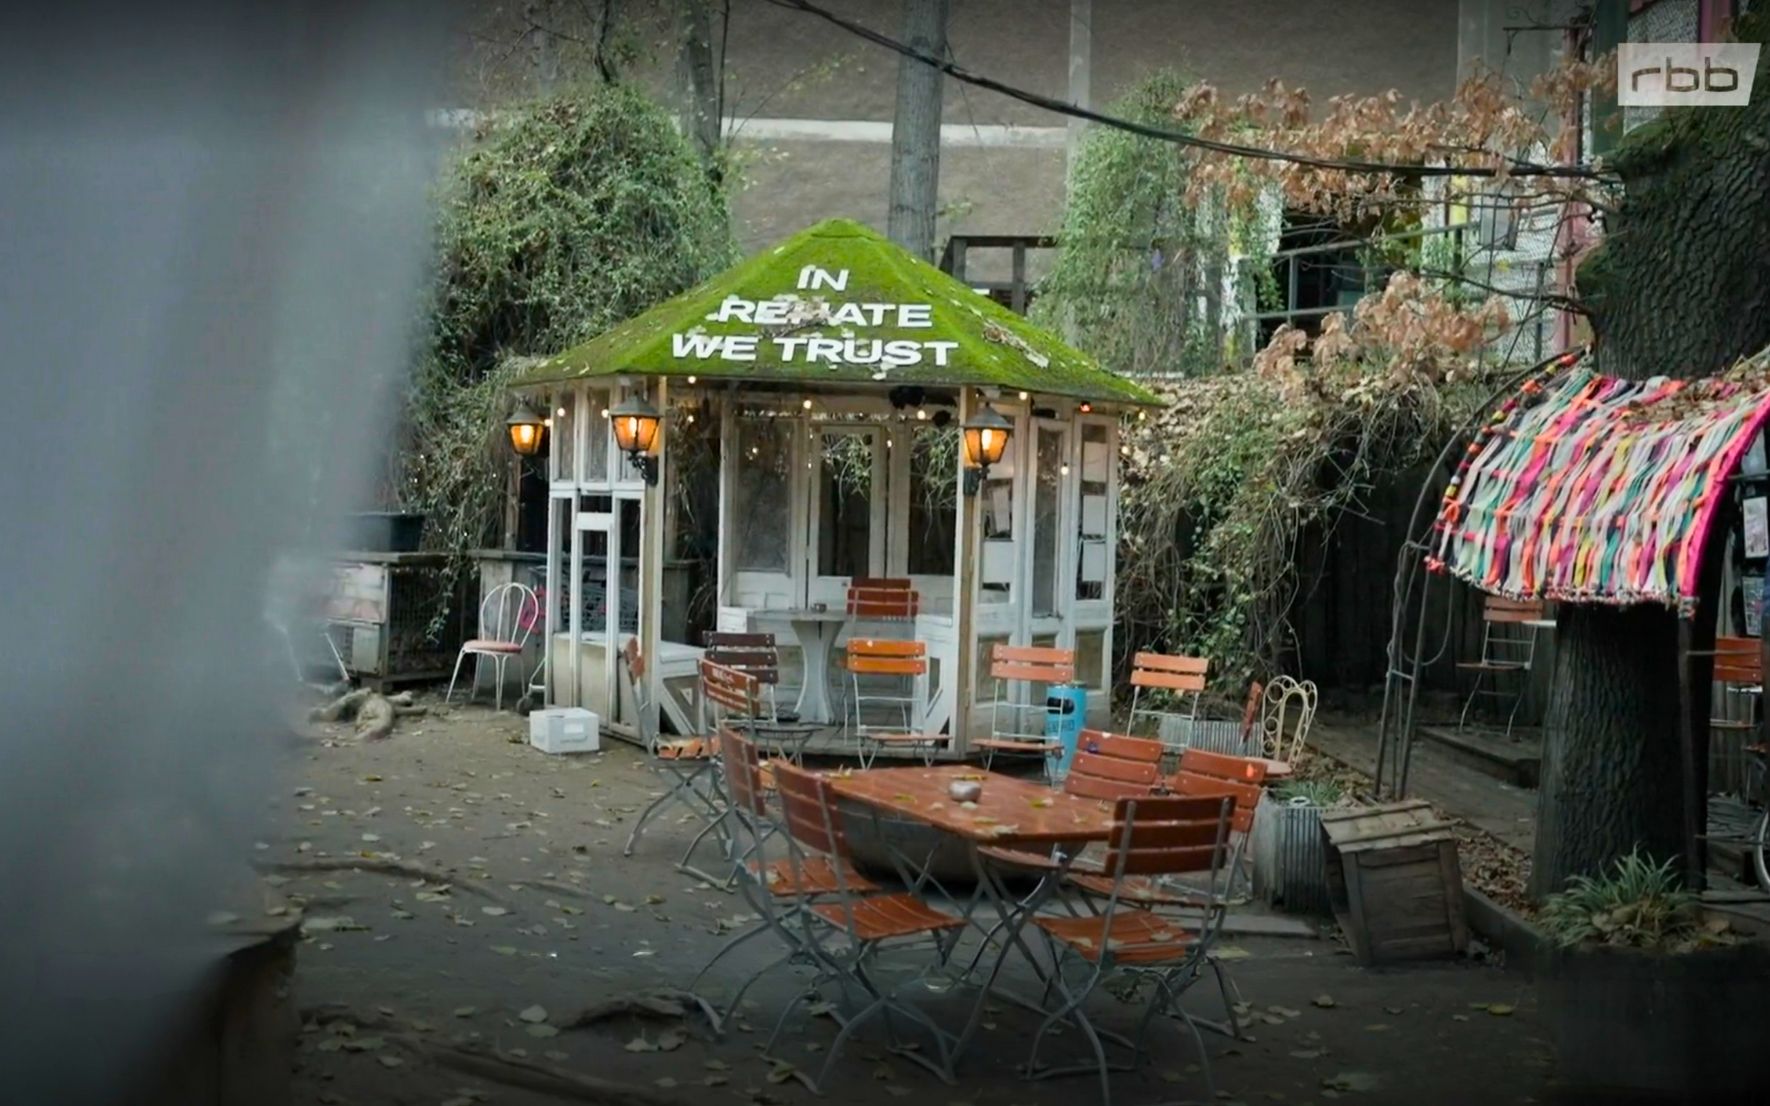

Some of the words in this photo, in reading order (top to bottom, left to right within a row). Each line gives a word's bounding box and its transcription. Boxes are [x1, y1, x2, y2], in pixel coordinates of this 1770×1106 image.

[797, 265, 849, 291] IN
[672, 334, 758, 361] WE
[773, 338, 959, 366] TRUST
